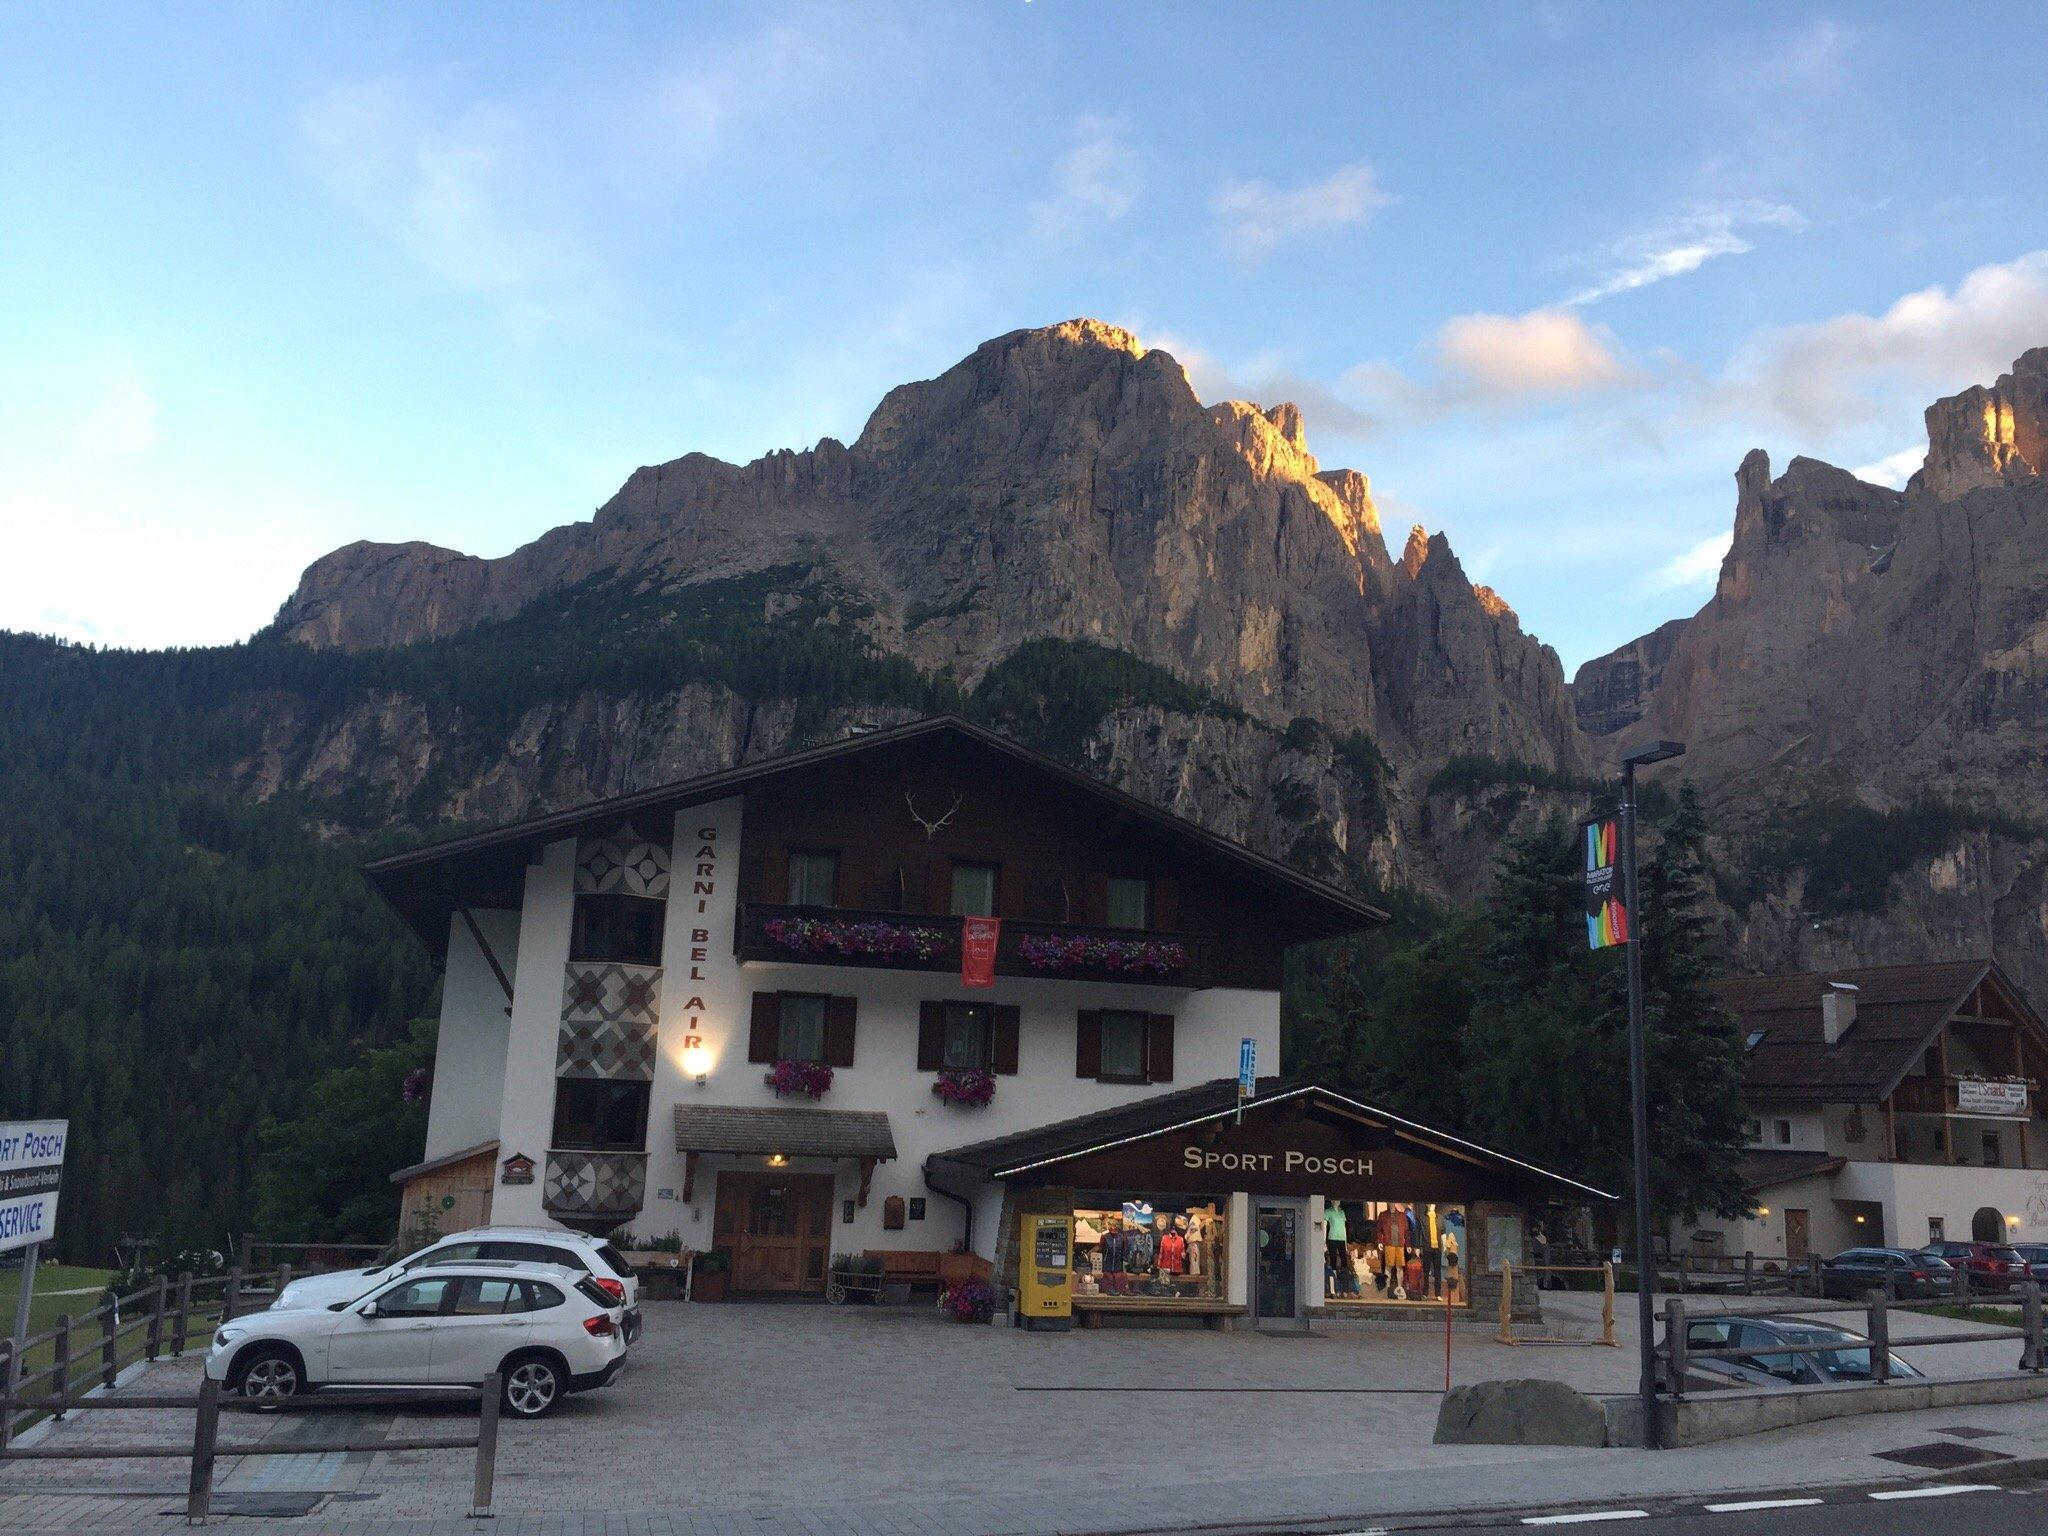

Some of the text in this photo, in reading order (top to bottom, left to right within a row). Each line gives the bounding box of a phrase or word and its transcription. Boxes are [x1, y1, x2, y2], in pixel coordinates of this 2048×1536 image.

[683, 827, 717, 1049] GARNI BEL AIR
[22, 1132, 63, 1160] POSCH
[1183, 1146, 1374, 1176] SPORT POSCH
